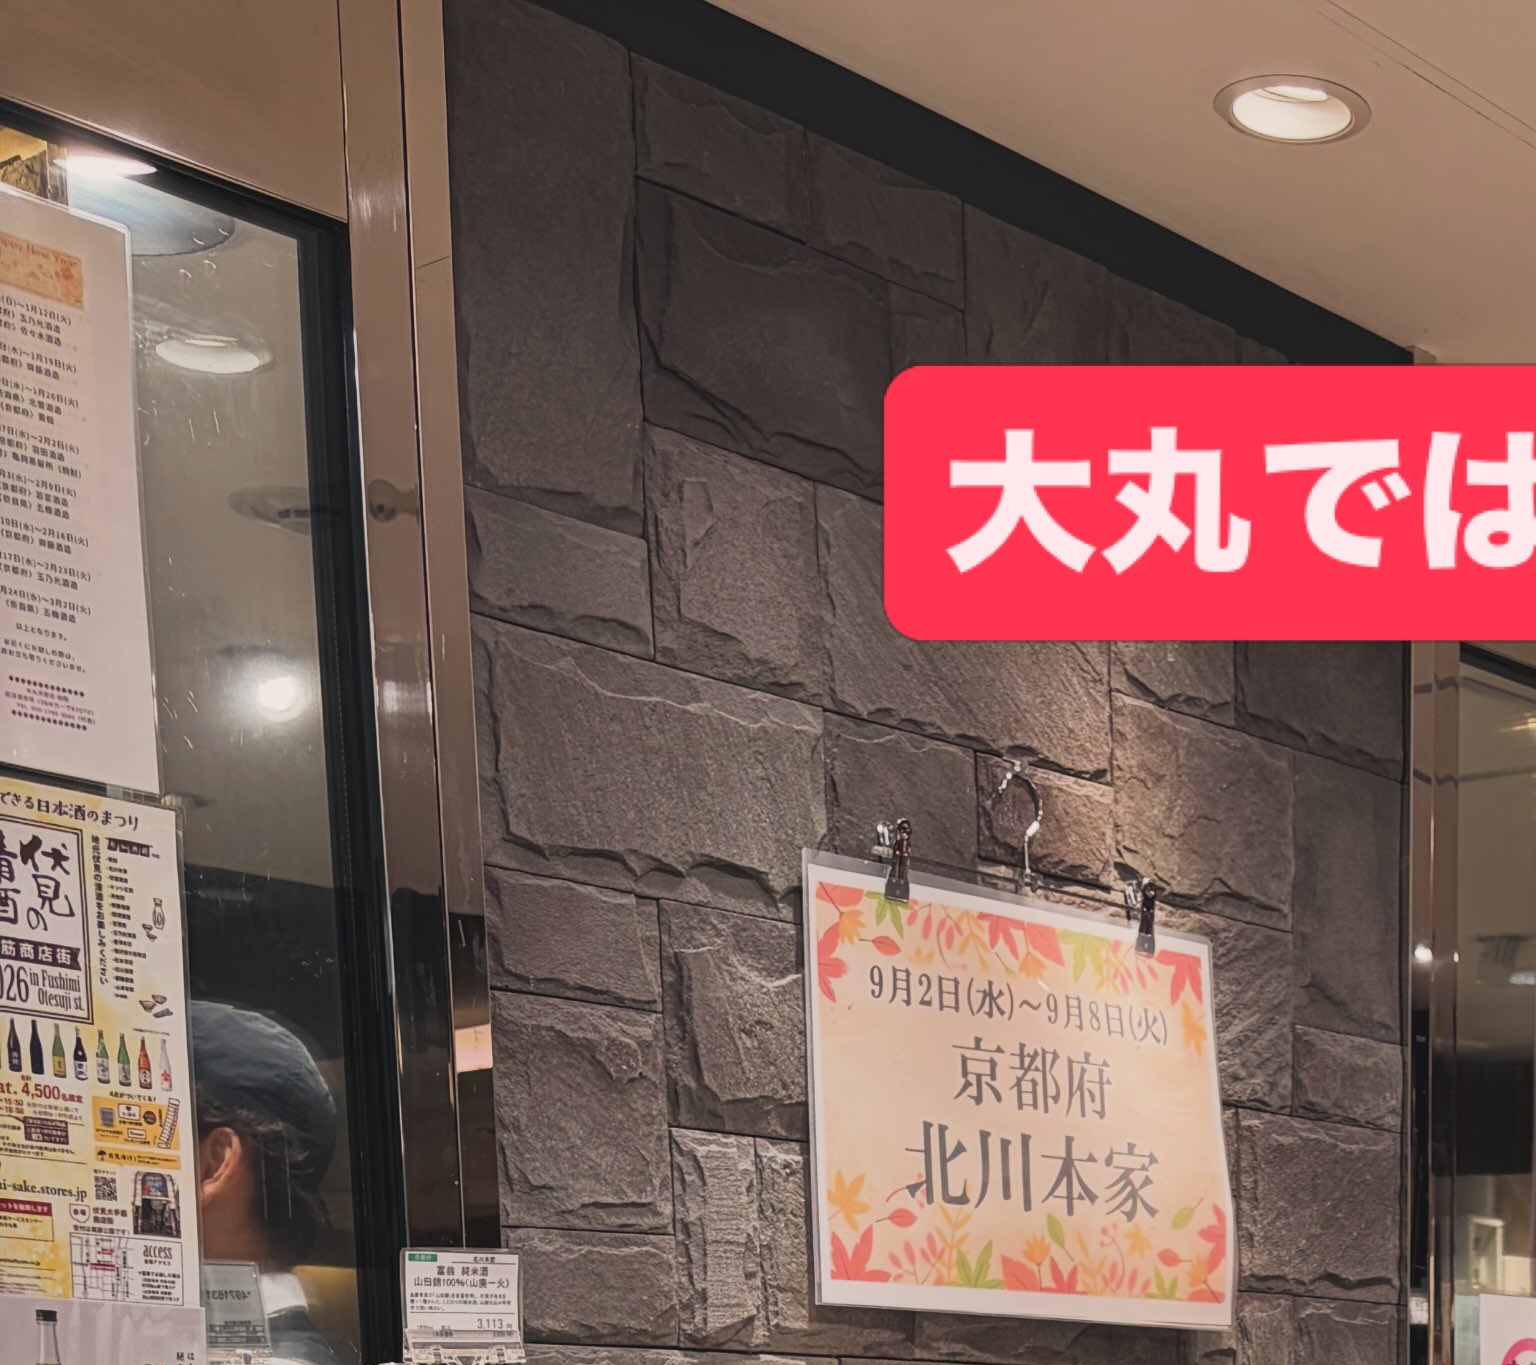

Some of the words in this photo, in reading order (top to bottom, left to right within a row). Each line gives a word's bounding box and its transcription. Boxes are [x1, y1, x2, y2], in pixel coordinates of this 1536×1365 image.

[42, 969, 81, 992] Fushimi
[952, 1035, 1113, 1121] 京都府
[904, 1119, 1160, 1223] 北川本家
[461, 1266, 489, 1277] 純米酒
